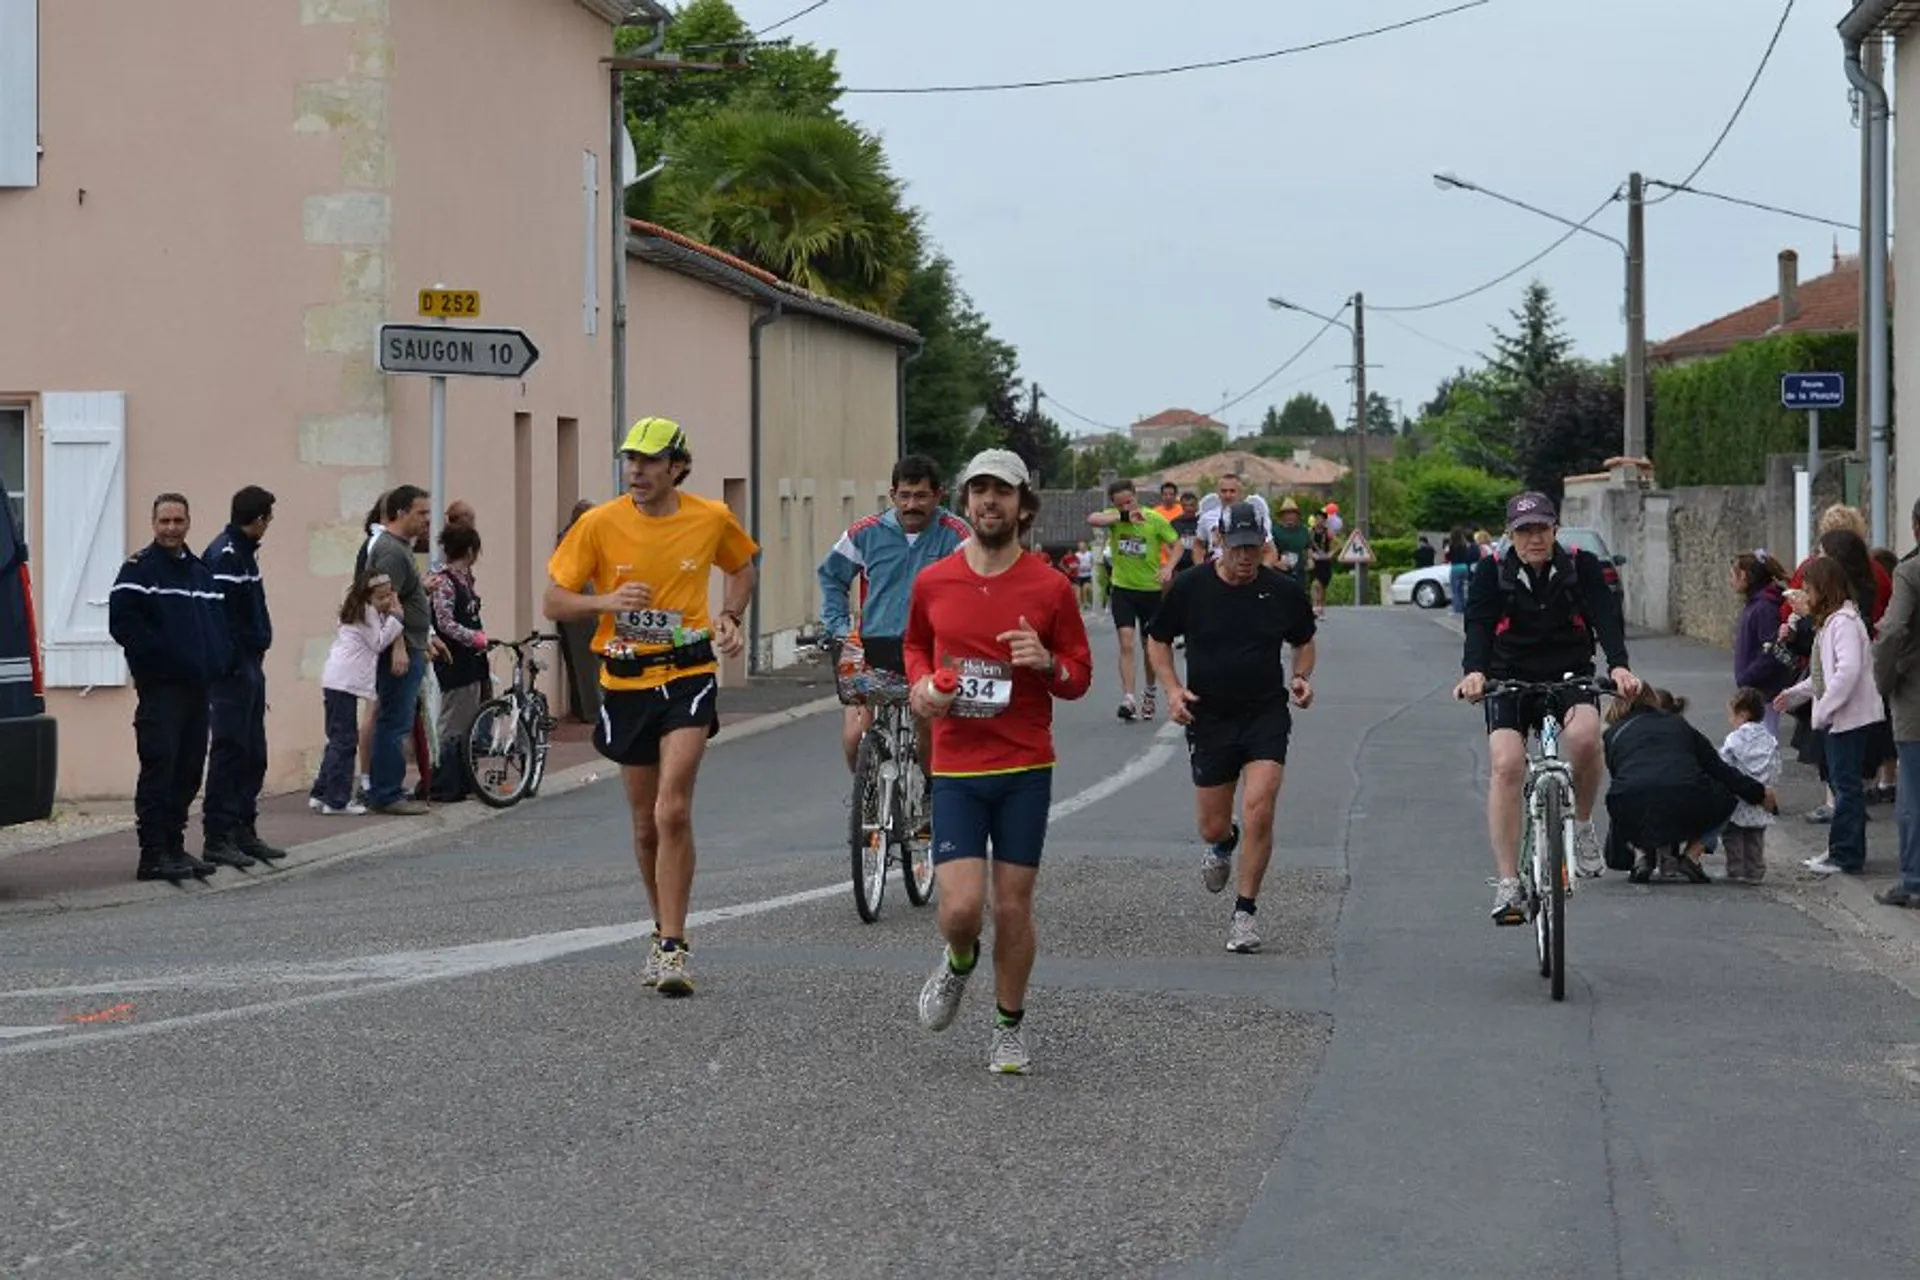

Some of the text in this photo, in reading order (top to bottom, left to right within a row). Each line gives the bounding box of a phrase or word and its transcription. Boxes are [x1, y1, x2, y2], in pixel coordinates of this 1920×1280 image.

[423, 294, 476, 313] D 252
[390, 338, 513, 364] SAUGON 10
[629, 611, 668, 628] 633
